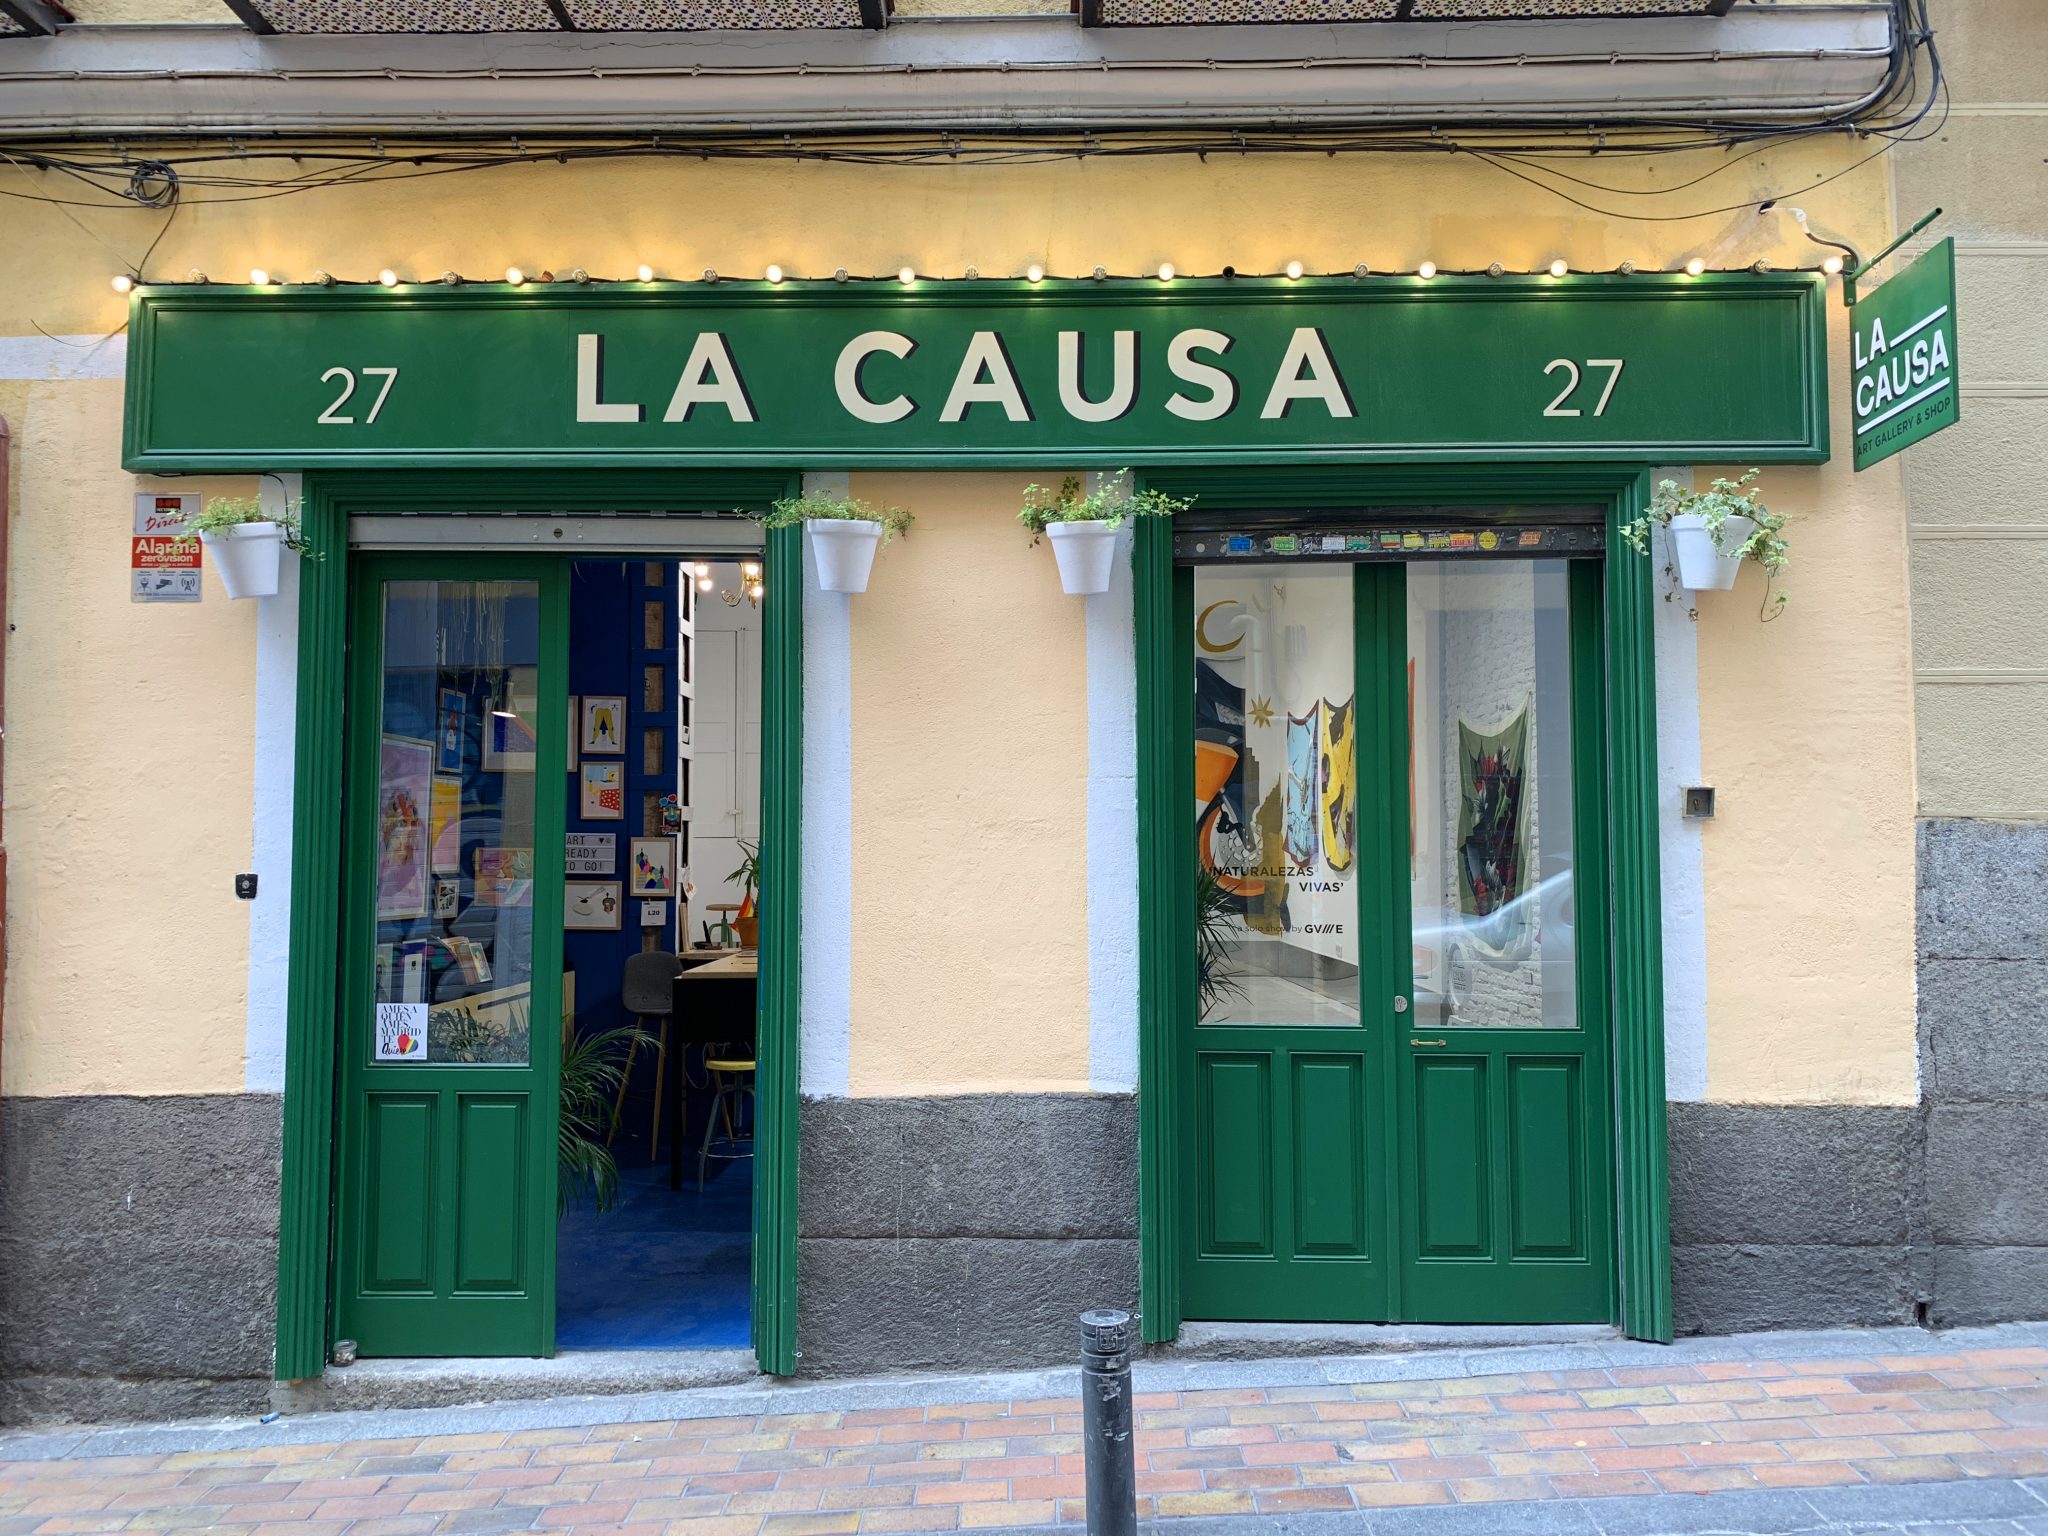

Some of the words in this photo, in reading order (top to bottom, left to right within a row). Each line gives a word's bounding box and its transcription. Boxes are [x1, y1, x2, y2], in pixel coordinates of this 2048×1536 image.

[1854, 317, 1887, 370] LA
[318, 367, 398, 425] 27
[576, 332, 755, 424] LA
[834, 328, 1354, 424] CAUSA
[1543, 358, 1623, 419] 27
[1856, 329, 1950, 418] CAUSA
[1857, 439, 1873, 457] ART
[1874, 416, 1914, 448] GALLERY
[1916, 412, 1923, 425] &
[1924, 397, 1951, 420] SHOP
[135, 538, 200, 554] Alarma
[567, 835, 585, 845] ART
[584, 861, 602, 871] GO!
[1245, 924, 1264, 932] solo
[1291, 924, 1303, 934] by
